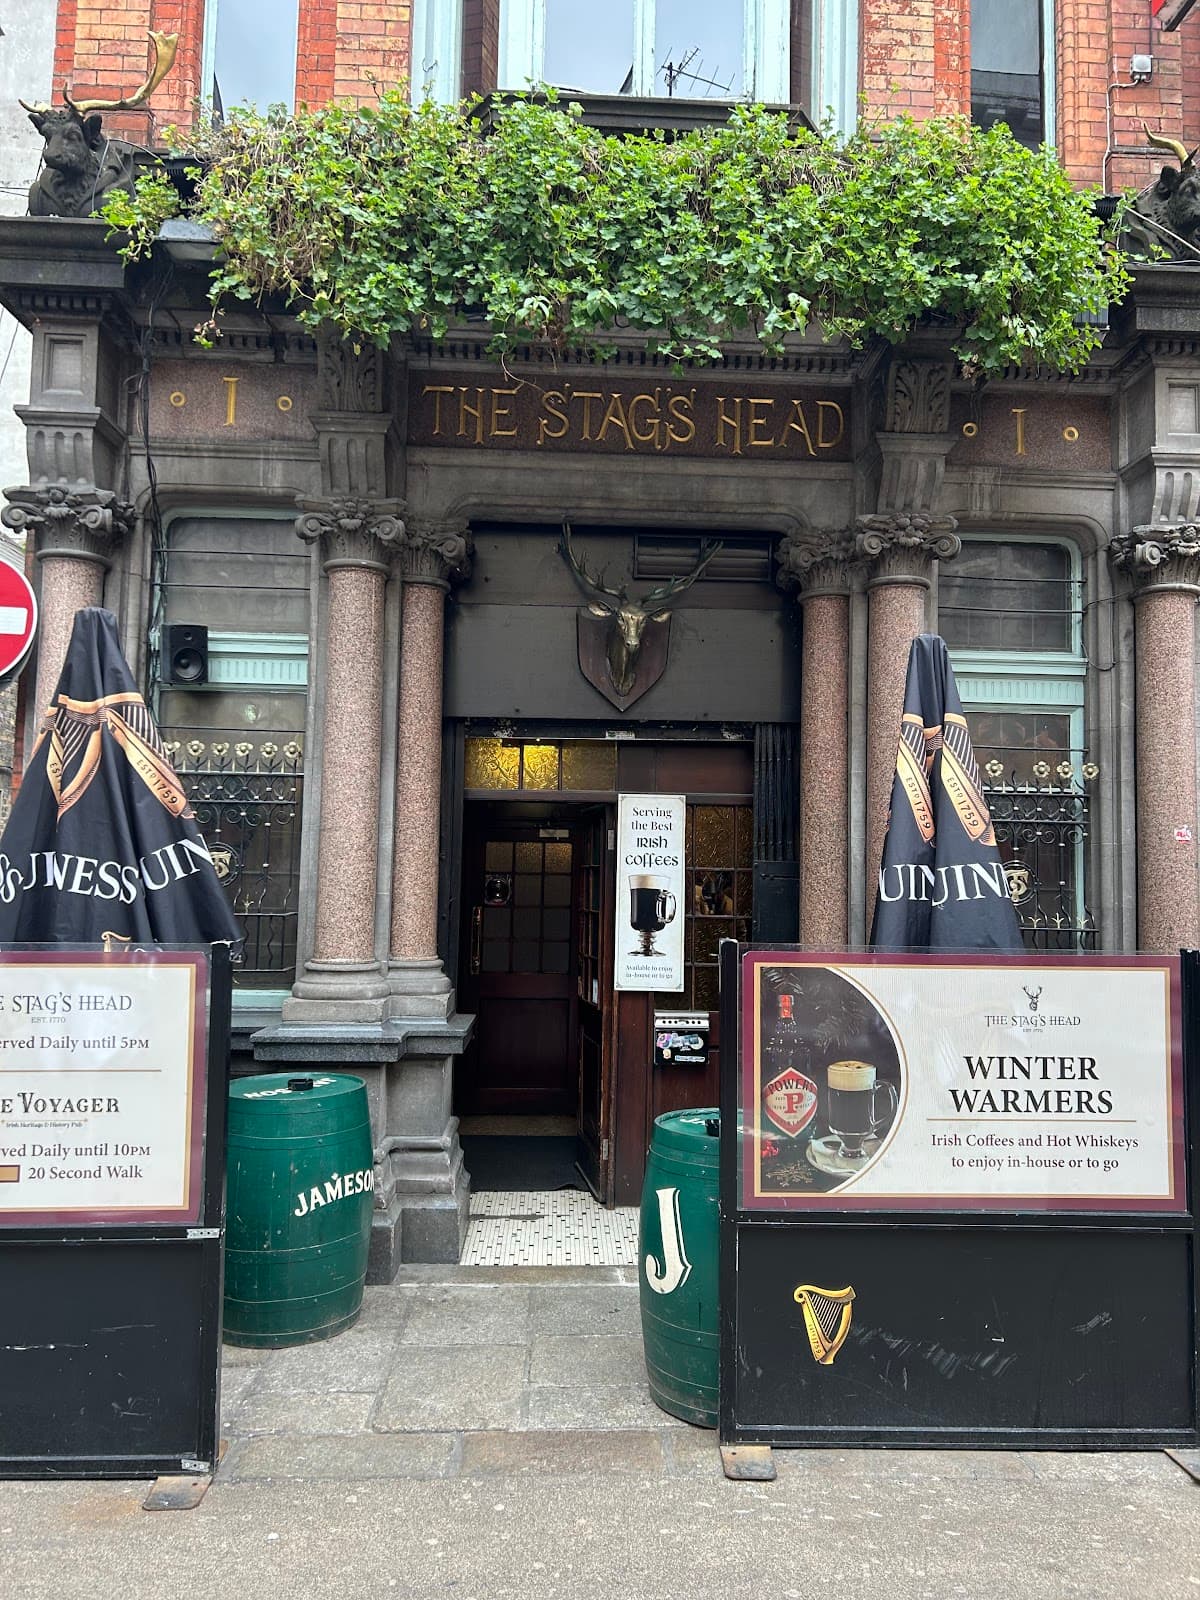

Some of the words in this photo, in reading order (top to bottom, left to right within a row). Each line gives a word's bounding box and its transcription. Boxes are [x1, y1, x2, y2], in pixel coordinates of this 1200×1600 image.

[422, 385, 518, 444] THE
[713, 396, 846, 457] HEAD
[153, 779, 178, 804] 1759
[632, 807, 673, 820] Serving
[913, 801, 932, 829] 1759
[957, 800, 979, 827] 1759
[631, 820, 648, 831] the
[651, 821, 672, 832] Best
[12, 991, 72, 1015] STAG'S
[78, 995, 132, 1011] HEAD
[984, 1015, 1008, 1028] THE
[1011, 1013, 1047, 1028] STAG'S
[1048, 1015, 1081, 1026] HEAD
[39, 1036, 79, 1053] Daily
[82, 1036, 116, 1049] until
[120, 1036, 149, 1049] 5PM
[963, 1055, 1100, 1080] WINTER
[767, 1079, 814, 1095] POWERS
[783, 1092, 804, 1114] P
[948, 1089, 1113, 1114] WARMERS
[31, 1143, 71, 1160] Daily
[74, 1143, 108, 1156] until
[114, 1143, 151, 1156] 10PM
[931, 1133, 962, 1147] Irish
[966, 1133, 1015, 1147] Coffees
[1017, 1134, 1043, 1148] and
[1047, 1135, 1072, 1148] Hot
[1075, 1134, 1140, 1151] Whiskeys
[28, 1167, 45, 1180] 20
[49, 1166, 102, 1179] Second
[106, 1165, 143, 1179] Walk
[951, 1156, 965, 1168] to
[968, 1155, 1004, 1171] enjoy
[1007, 1155, 1065, 1169] in-house
[1068, 1157, 1084, 1169] or
[1086, 1157, 1100, 1169] to
[1103, 1159, 1120, 1172] go
[645, 1187, 693, 1295] J
